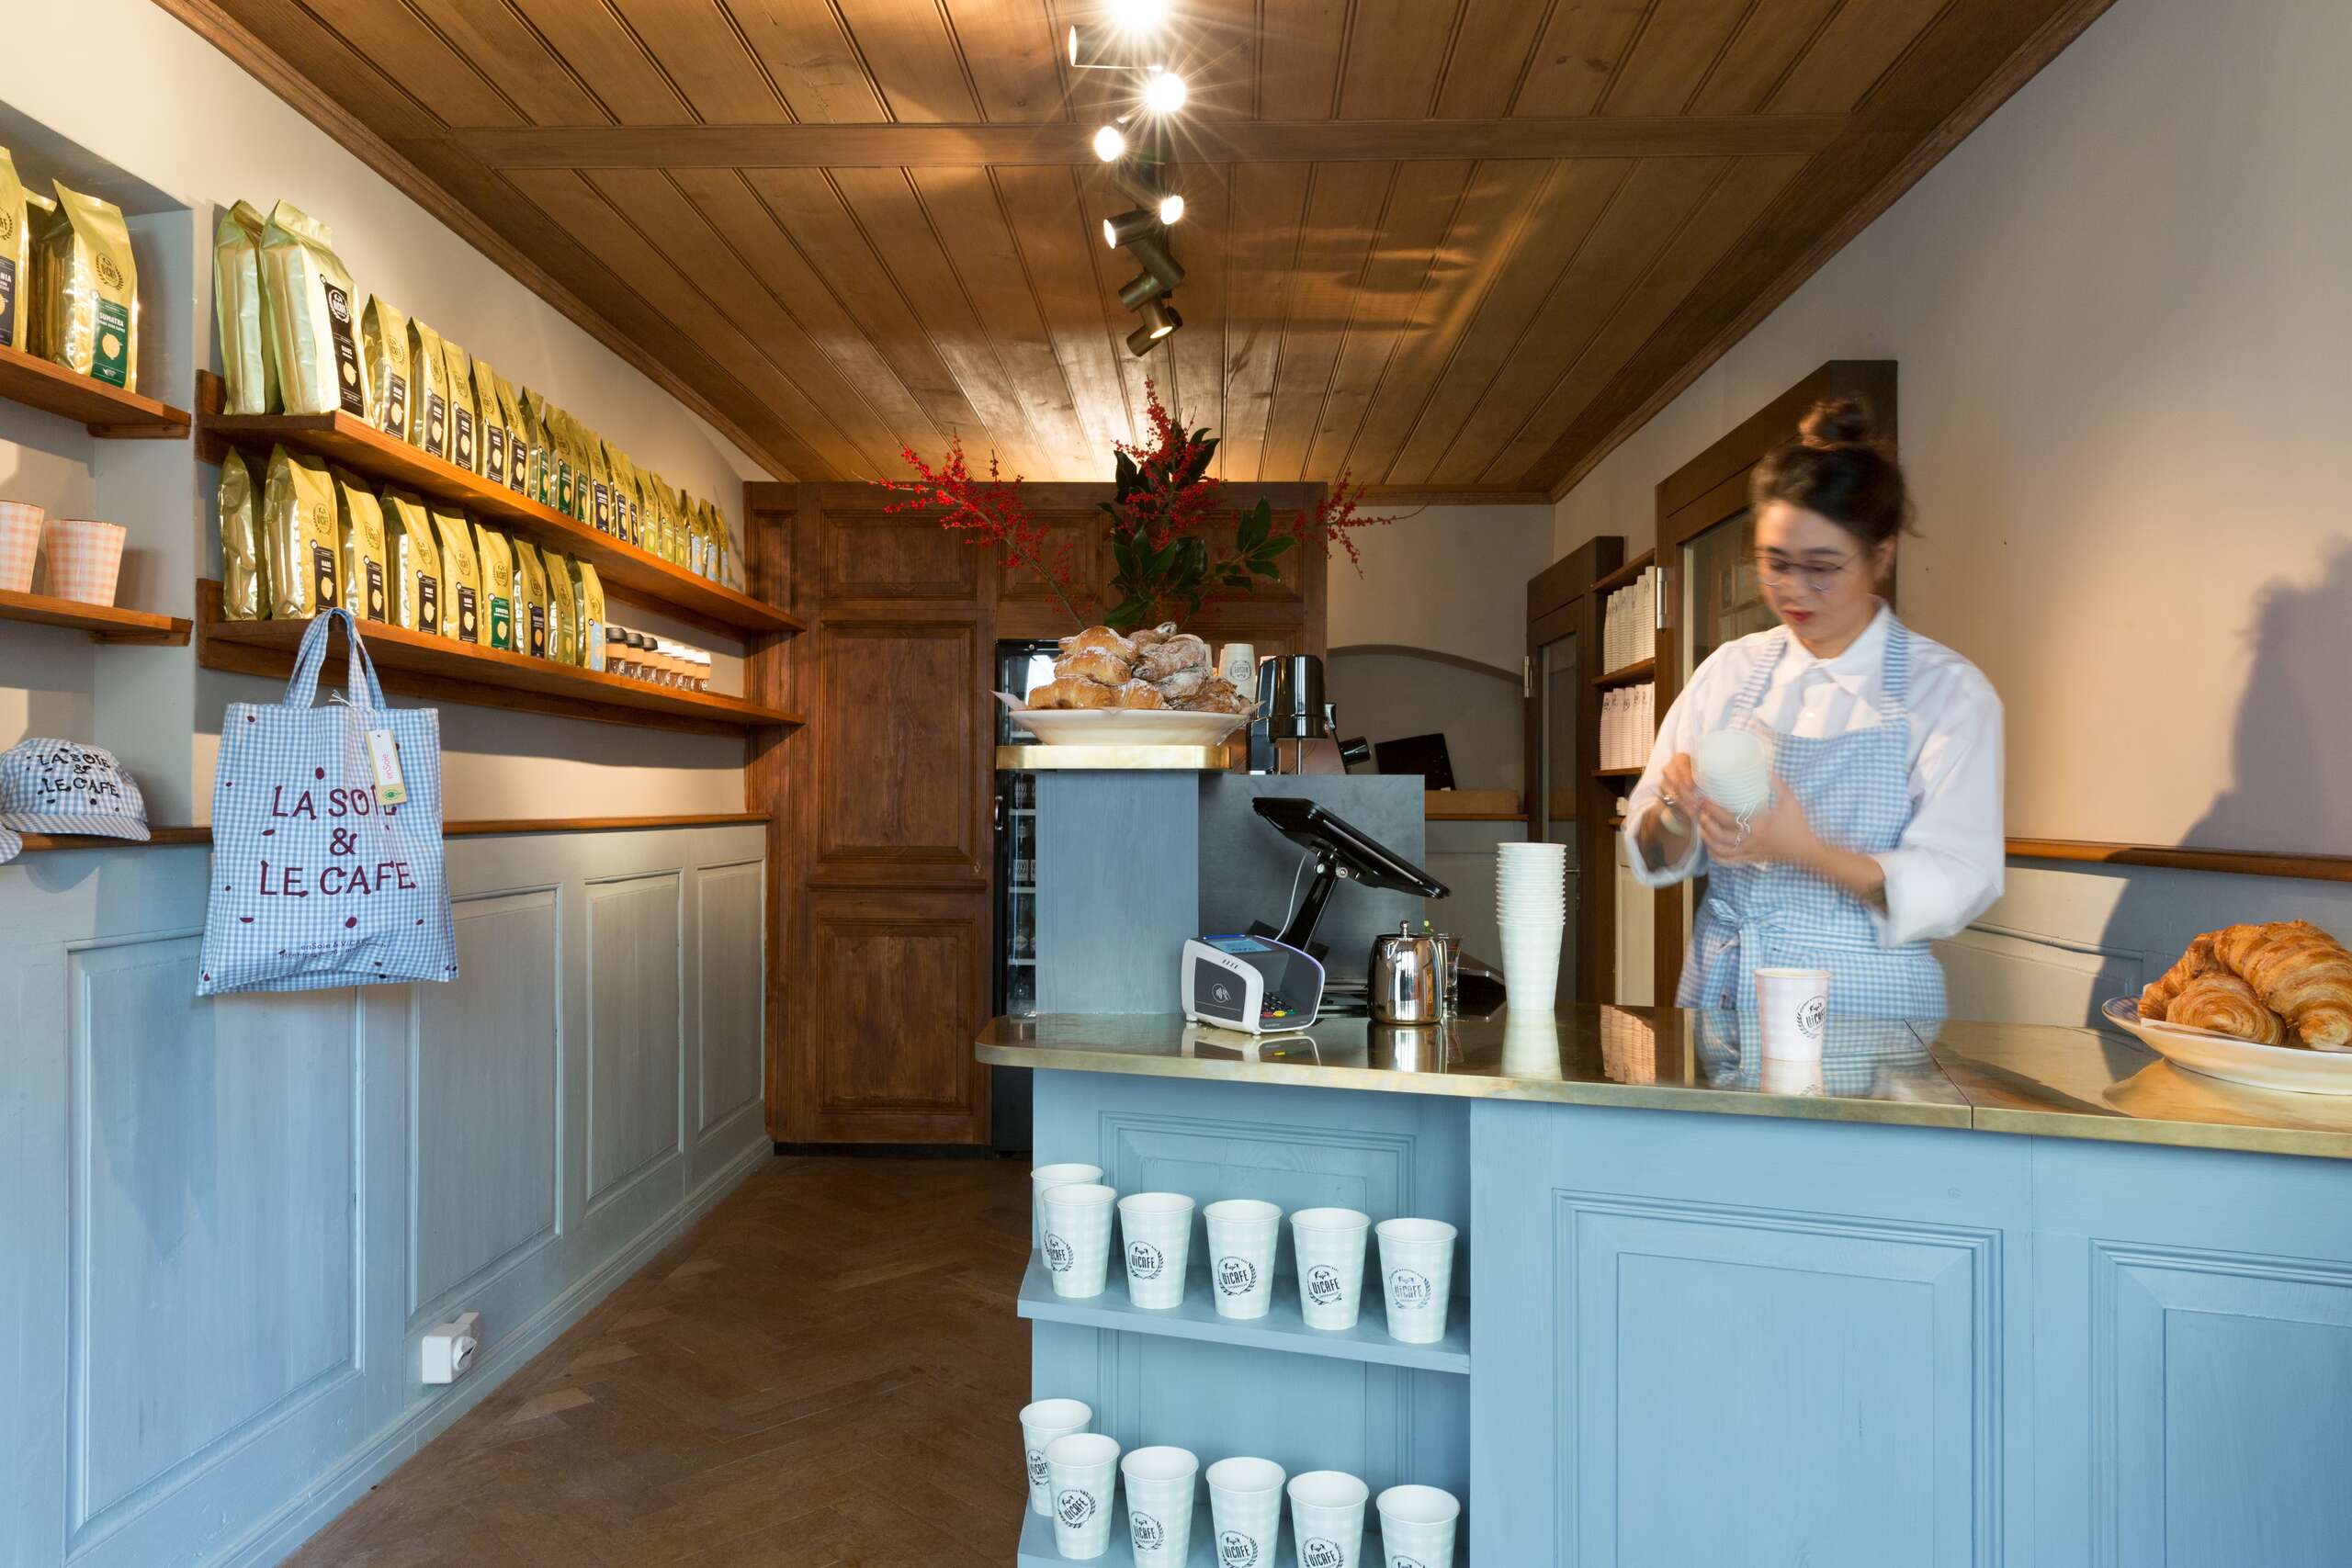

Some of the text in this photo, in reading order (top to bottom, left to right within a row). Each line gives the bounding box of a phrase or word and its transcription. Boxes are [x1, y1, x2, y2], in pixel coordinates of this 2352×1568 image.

[37, 753, 110, 768] LA SOIE
[74, 764, 91, 774] &
[41, 777, 120, 798] LE CAFE
[272, 785, 317, 820] LA
[329, 827, 357, 856] &
[260, 861, 416, 897] LE CAFE
